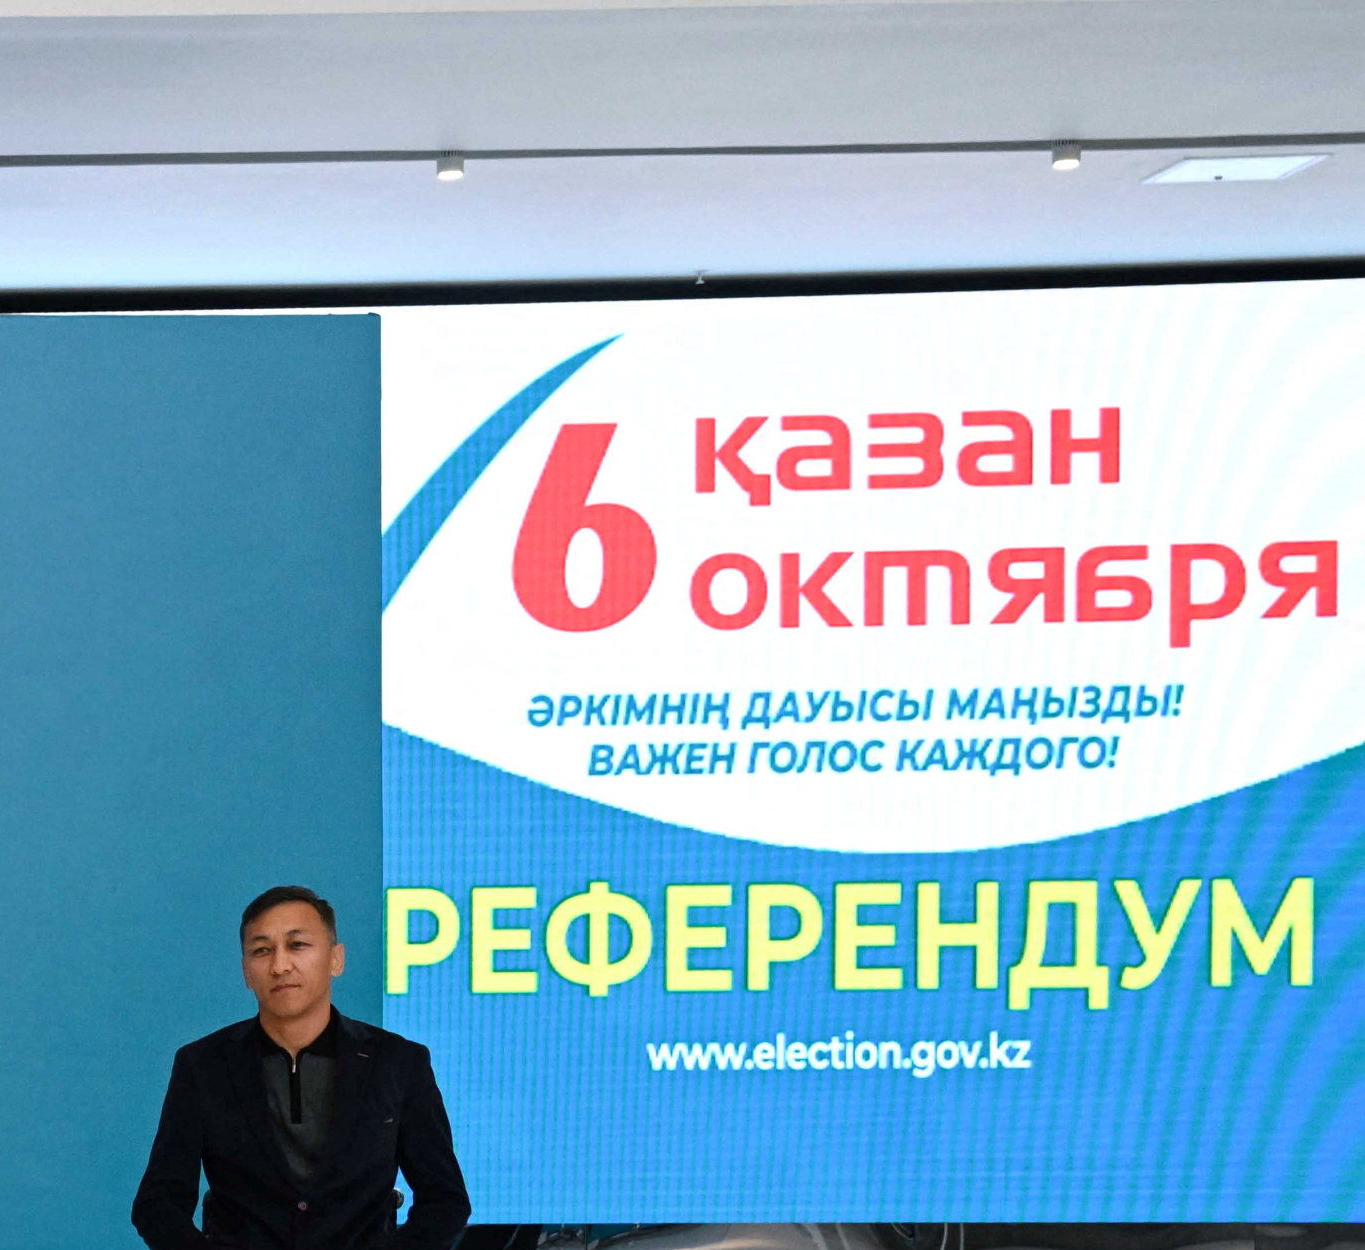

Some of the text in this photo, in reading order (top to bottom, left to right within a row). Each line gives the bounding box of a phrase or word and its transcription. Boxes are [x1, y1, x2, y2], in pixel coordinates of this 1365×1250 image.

[694, 406, 1122, 507] қазан
[512, 422, 658, 633] 6
[688, 539, 1340, 649] октября
[527, 684, 1185, 731] ӘРКІМНІҢ ДАУЫСЫ МАҢЫЗДЫ!
[587, 736, 1122, 777] ВАЖЕН ГОЛОС КАЖДОГО!
[386, 876, 1316, 1010] РЕФЕРЕНДУМ
[646, 1031, 1032, 1078] www.election.gov.kz
